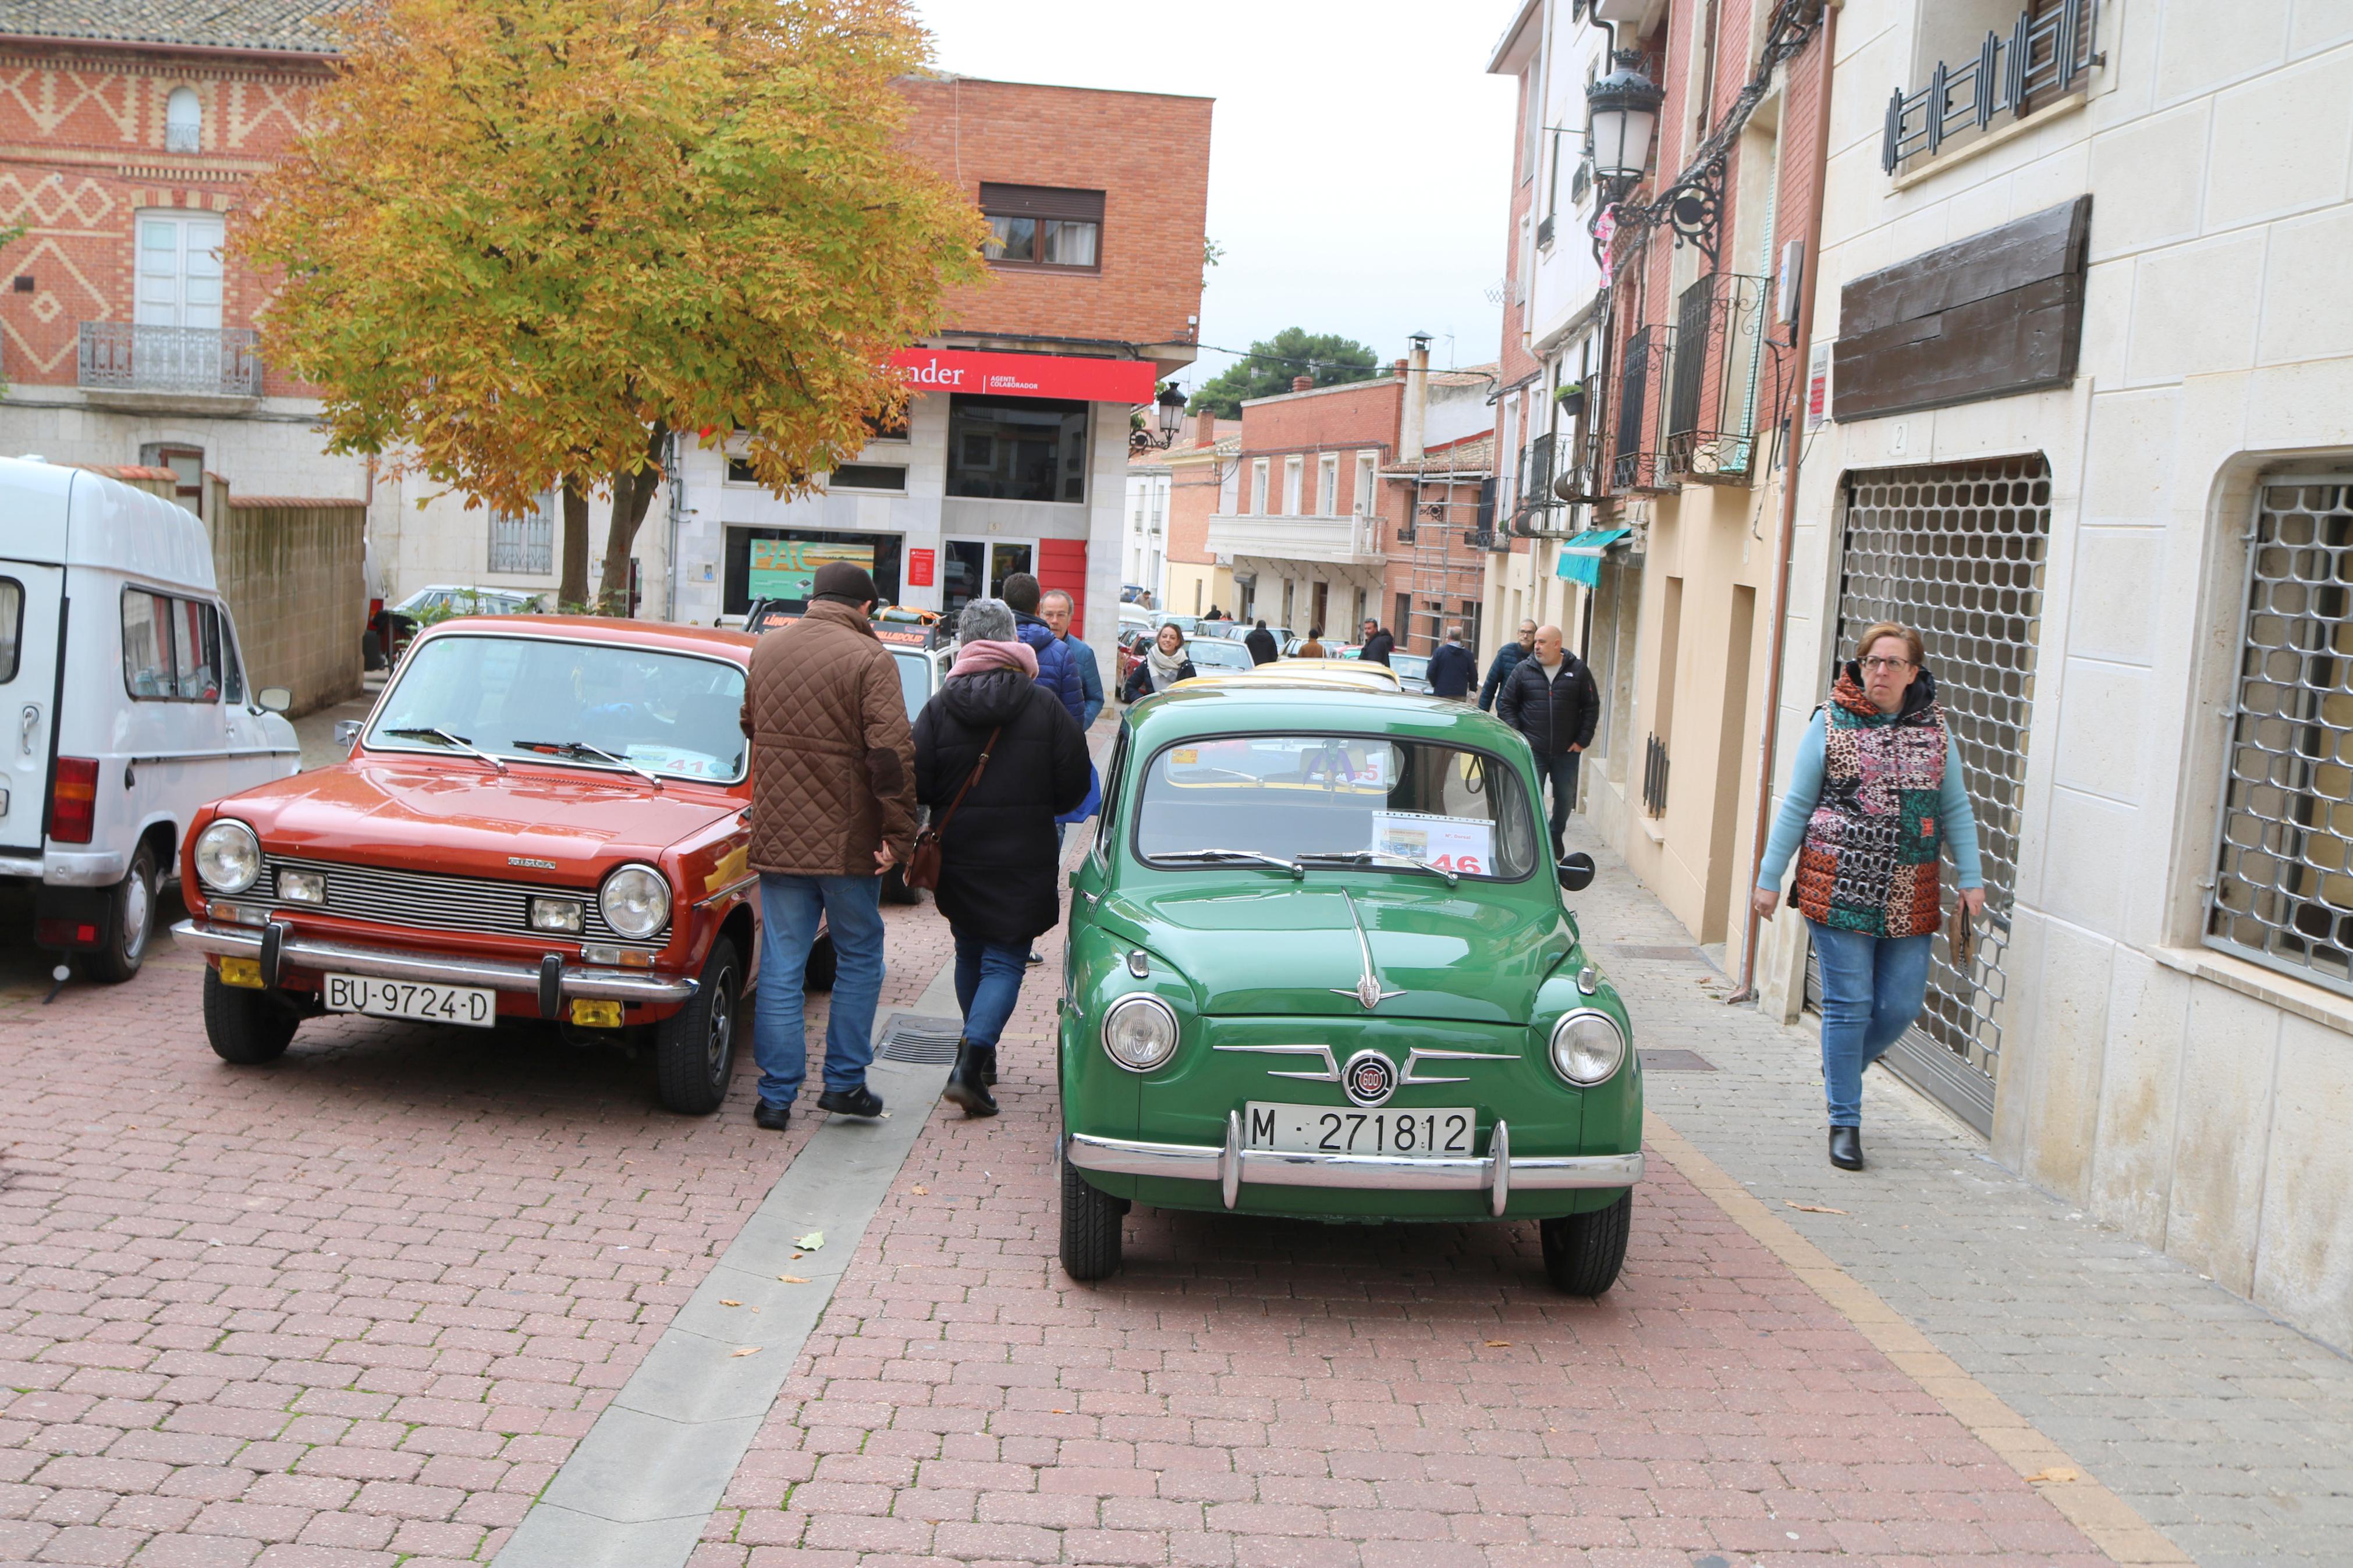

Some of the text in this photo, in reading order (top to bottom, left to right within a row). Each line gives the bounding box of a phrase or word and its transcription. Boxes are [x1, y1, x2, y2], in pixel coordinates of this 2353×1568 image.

[990, 381, 1038, 389] COLABORADOR
[1896, 426, 1903, 449] 2
[751, 539, 817, 571] PAC
[875, 631, 924, 643] VALLADOLID
[666, 759, 704, 773] 41
[509, 857, 555, 869] SIMCA
[1431, 854, 1481, 874] 46
[331, 978, 488, 1022] BU-9724-D
[1364, 986, 1376, 1000] SEAT
[1363, 1073, 1379, 1086] 600
